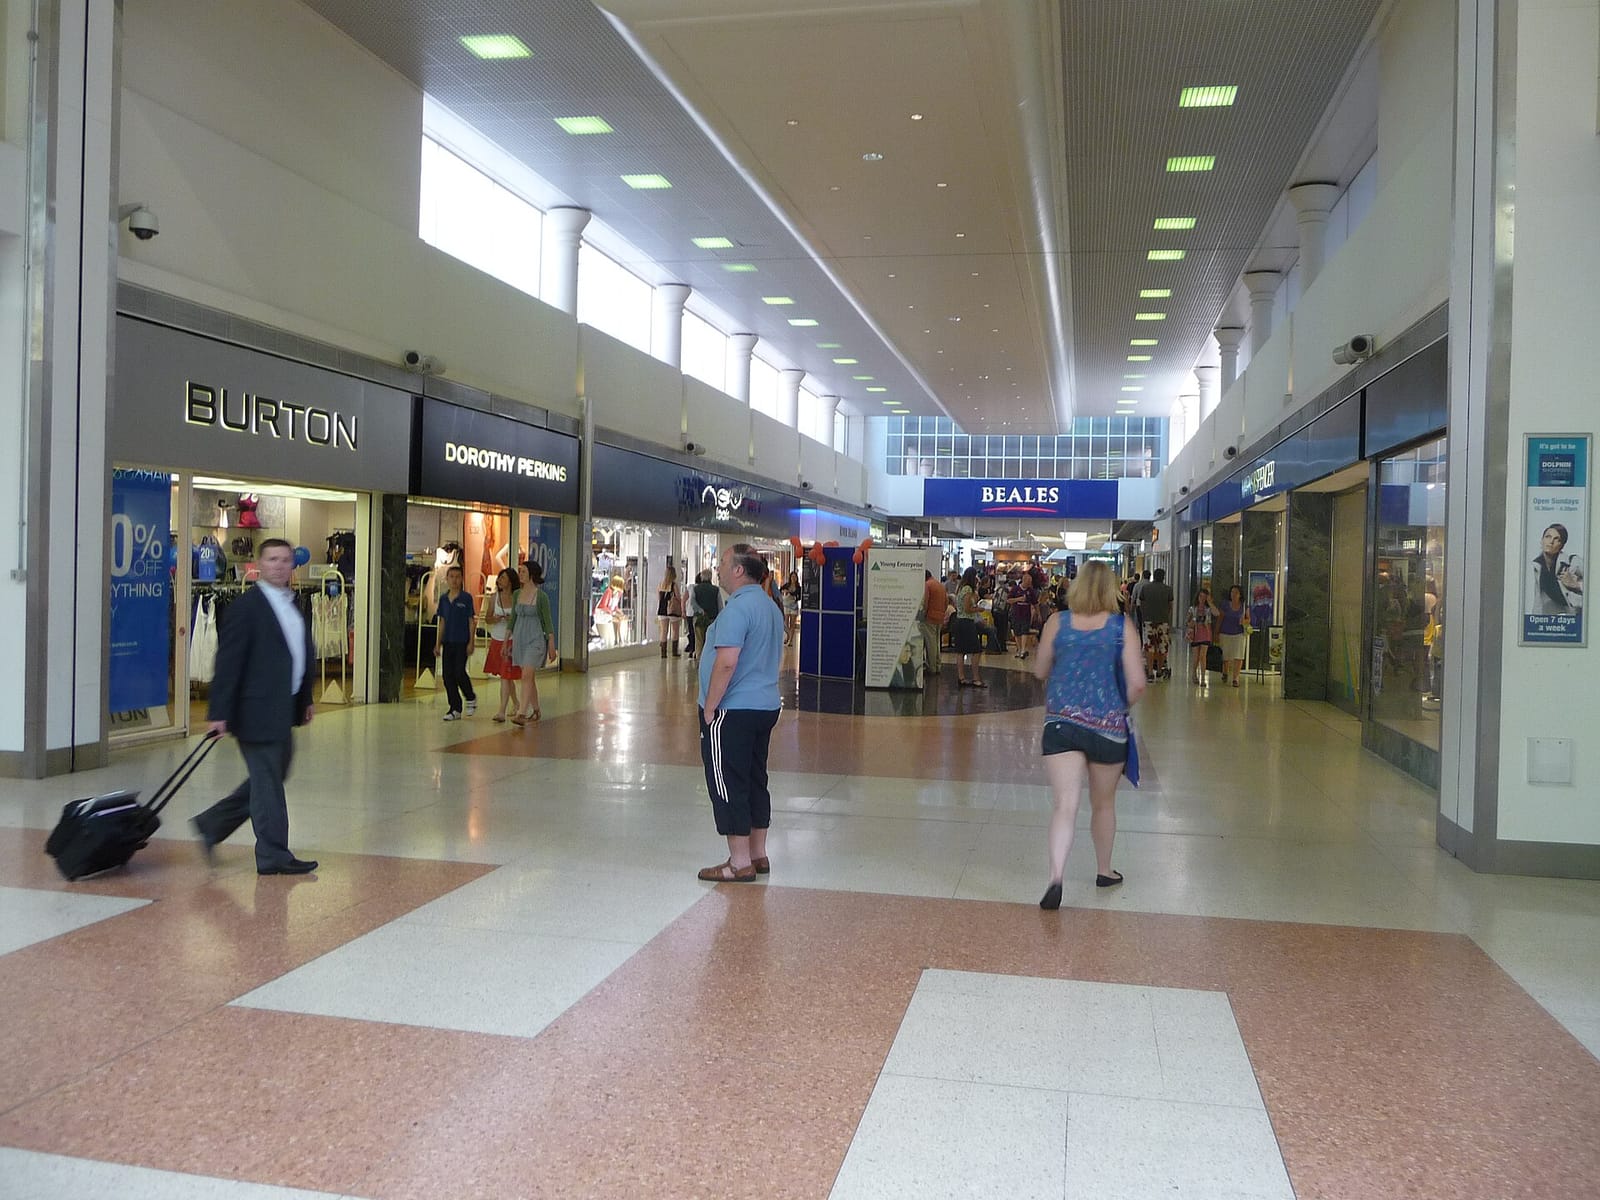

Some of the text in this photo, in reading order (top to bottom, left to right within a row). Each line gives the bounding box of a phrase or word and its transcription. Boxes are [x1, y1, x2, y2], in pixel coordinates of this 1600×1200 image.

[185, 380, 358, 451] BURTON
[445, 442, 567, 482] DOROTHY PERKINS
[702, 485, 743, 510] new
[981, 486, 1060, 503] BEALES
[1533, 497, 1550, 505] Open
[134, 559, 163, 577] OFF
[896, 560, 923, 568] Enterprise
[1529, 615, 1549, 624] Open
[1557, 616, 1576, 625] days
[1545, 624, 1566, 632] week
